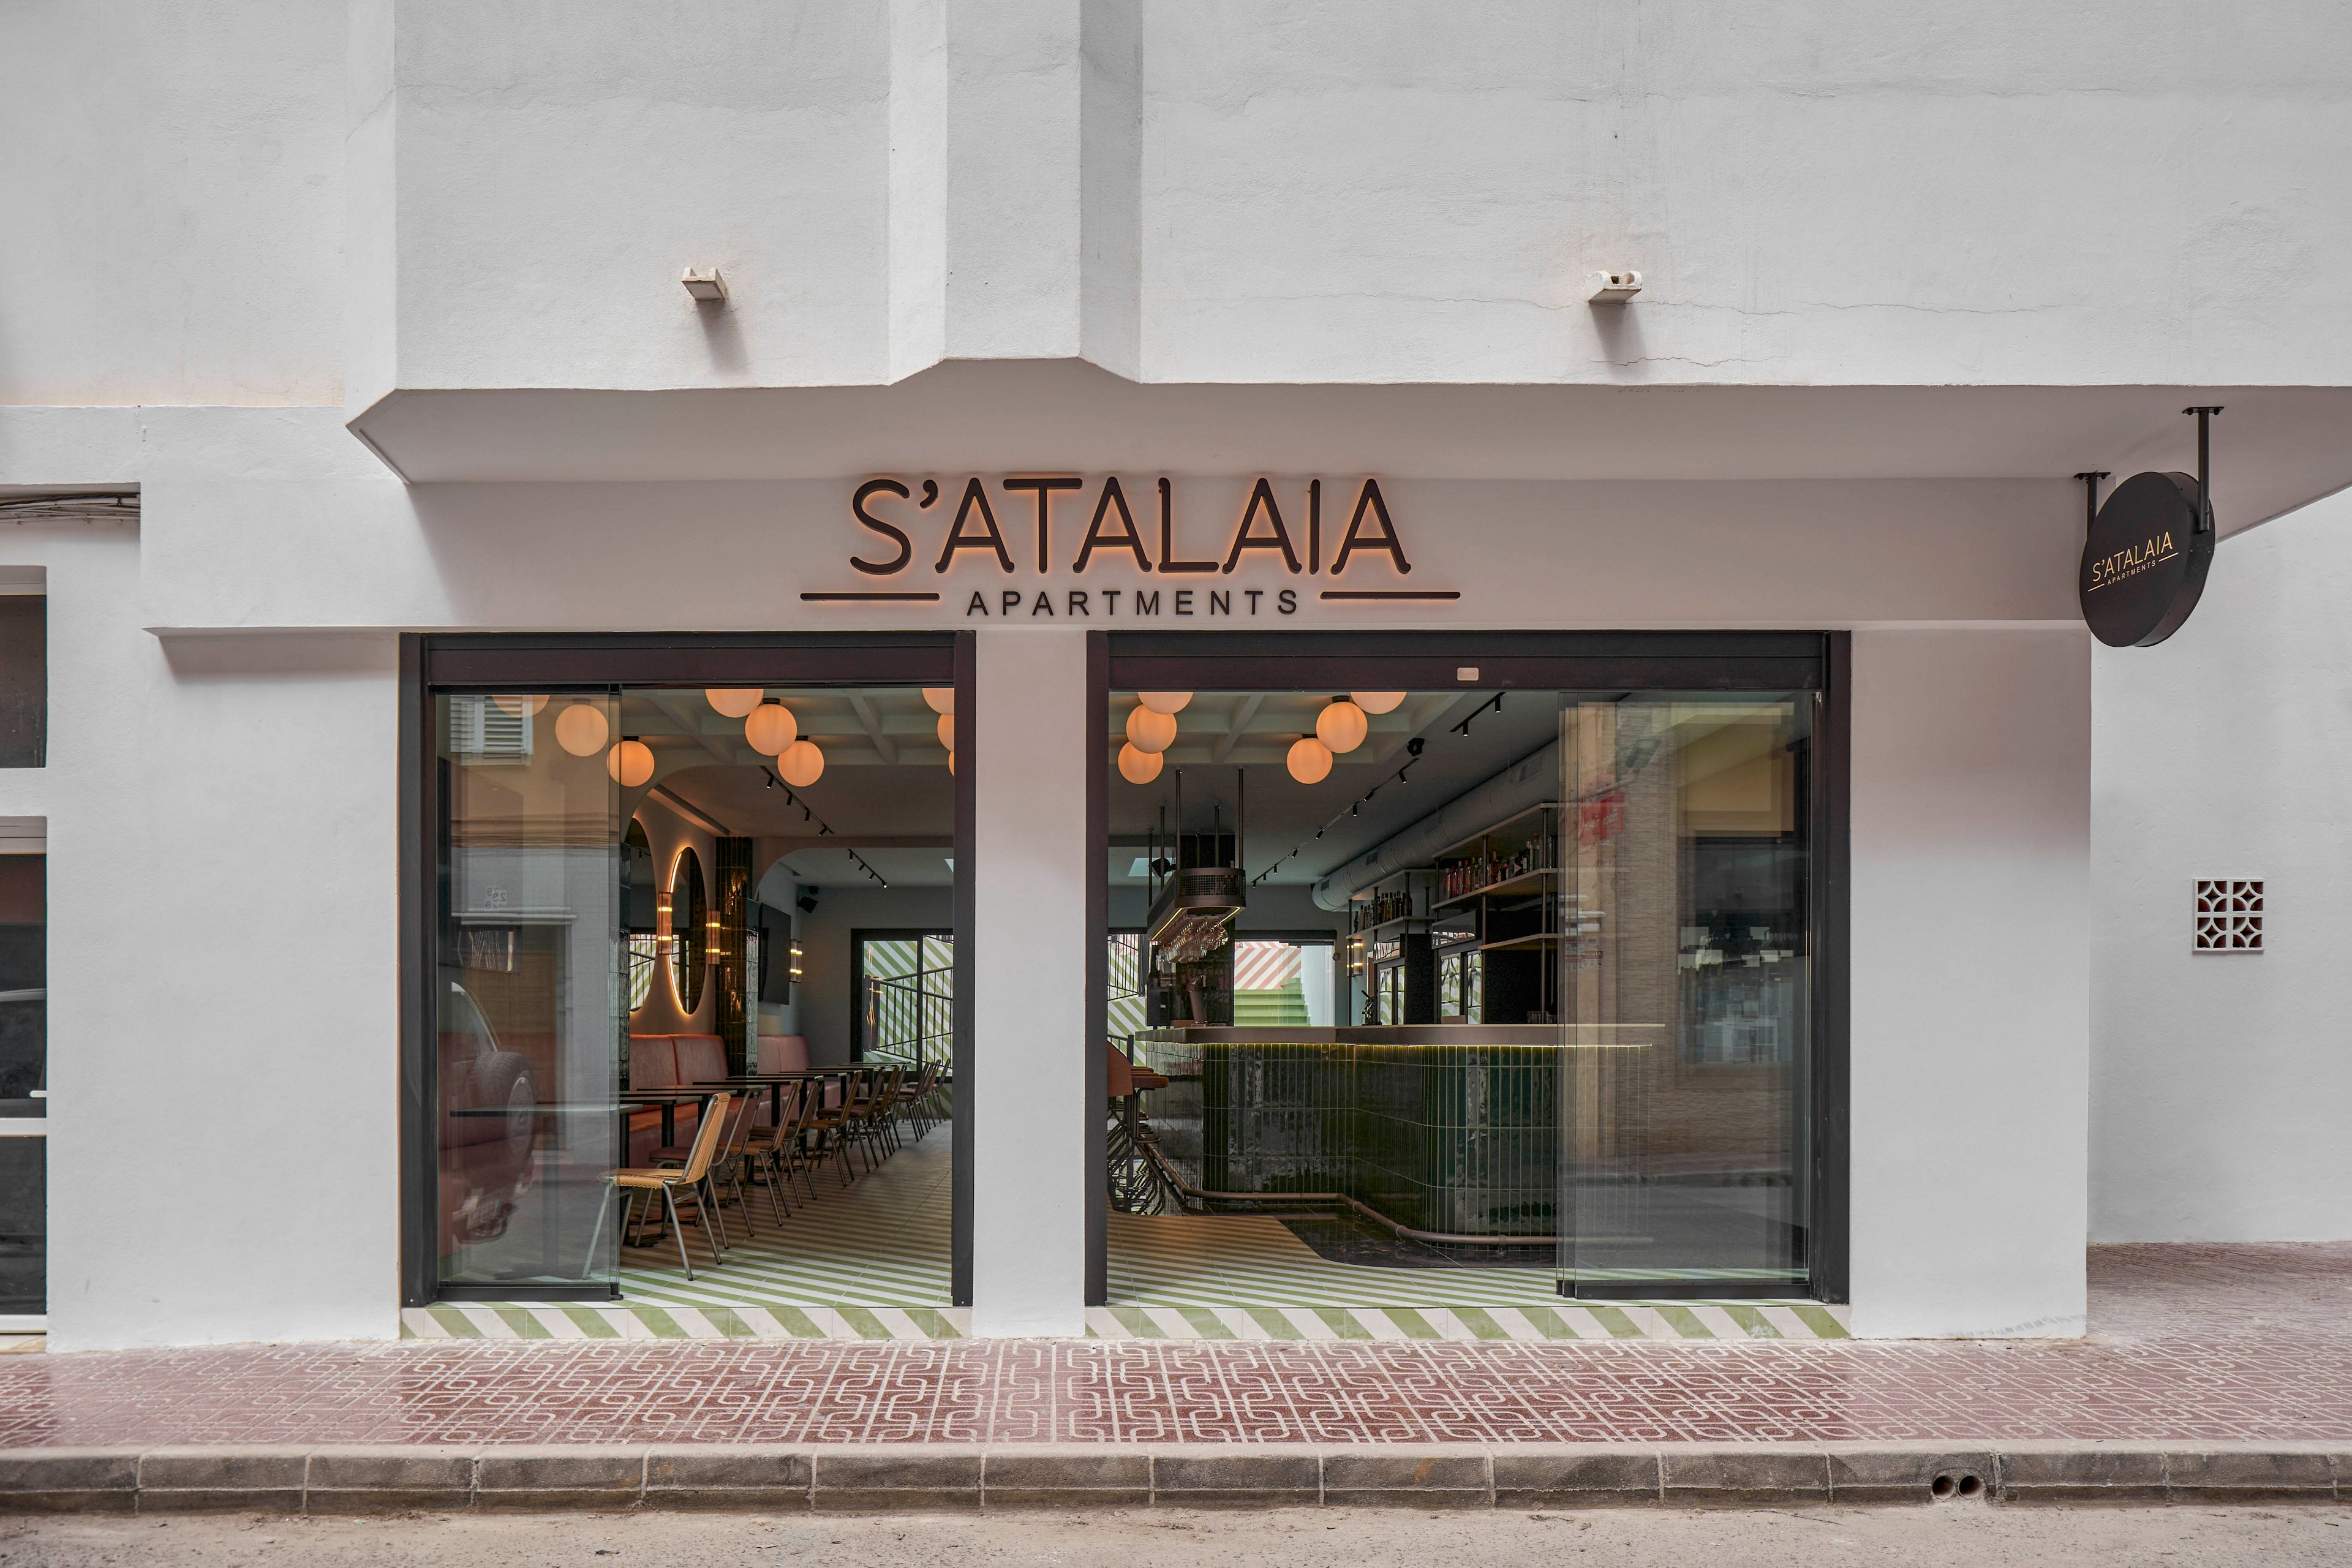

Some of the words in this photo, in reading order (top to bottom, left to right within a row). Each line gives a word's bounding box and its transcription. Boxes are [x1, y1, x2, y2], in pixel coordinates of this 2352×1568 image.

[850, 476, 1412, 575] S'ATALAIA
[2092, 531, 2173, 582] S'ATALAIA
[2107, 560, 2156, 586] APARTMENTS
[966, 589, 1299, 616] APARTMENTS
